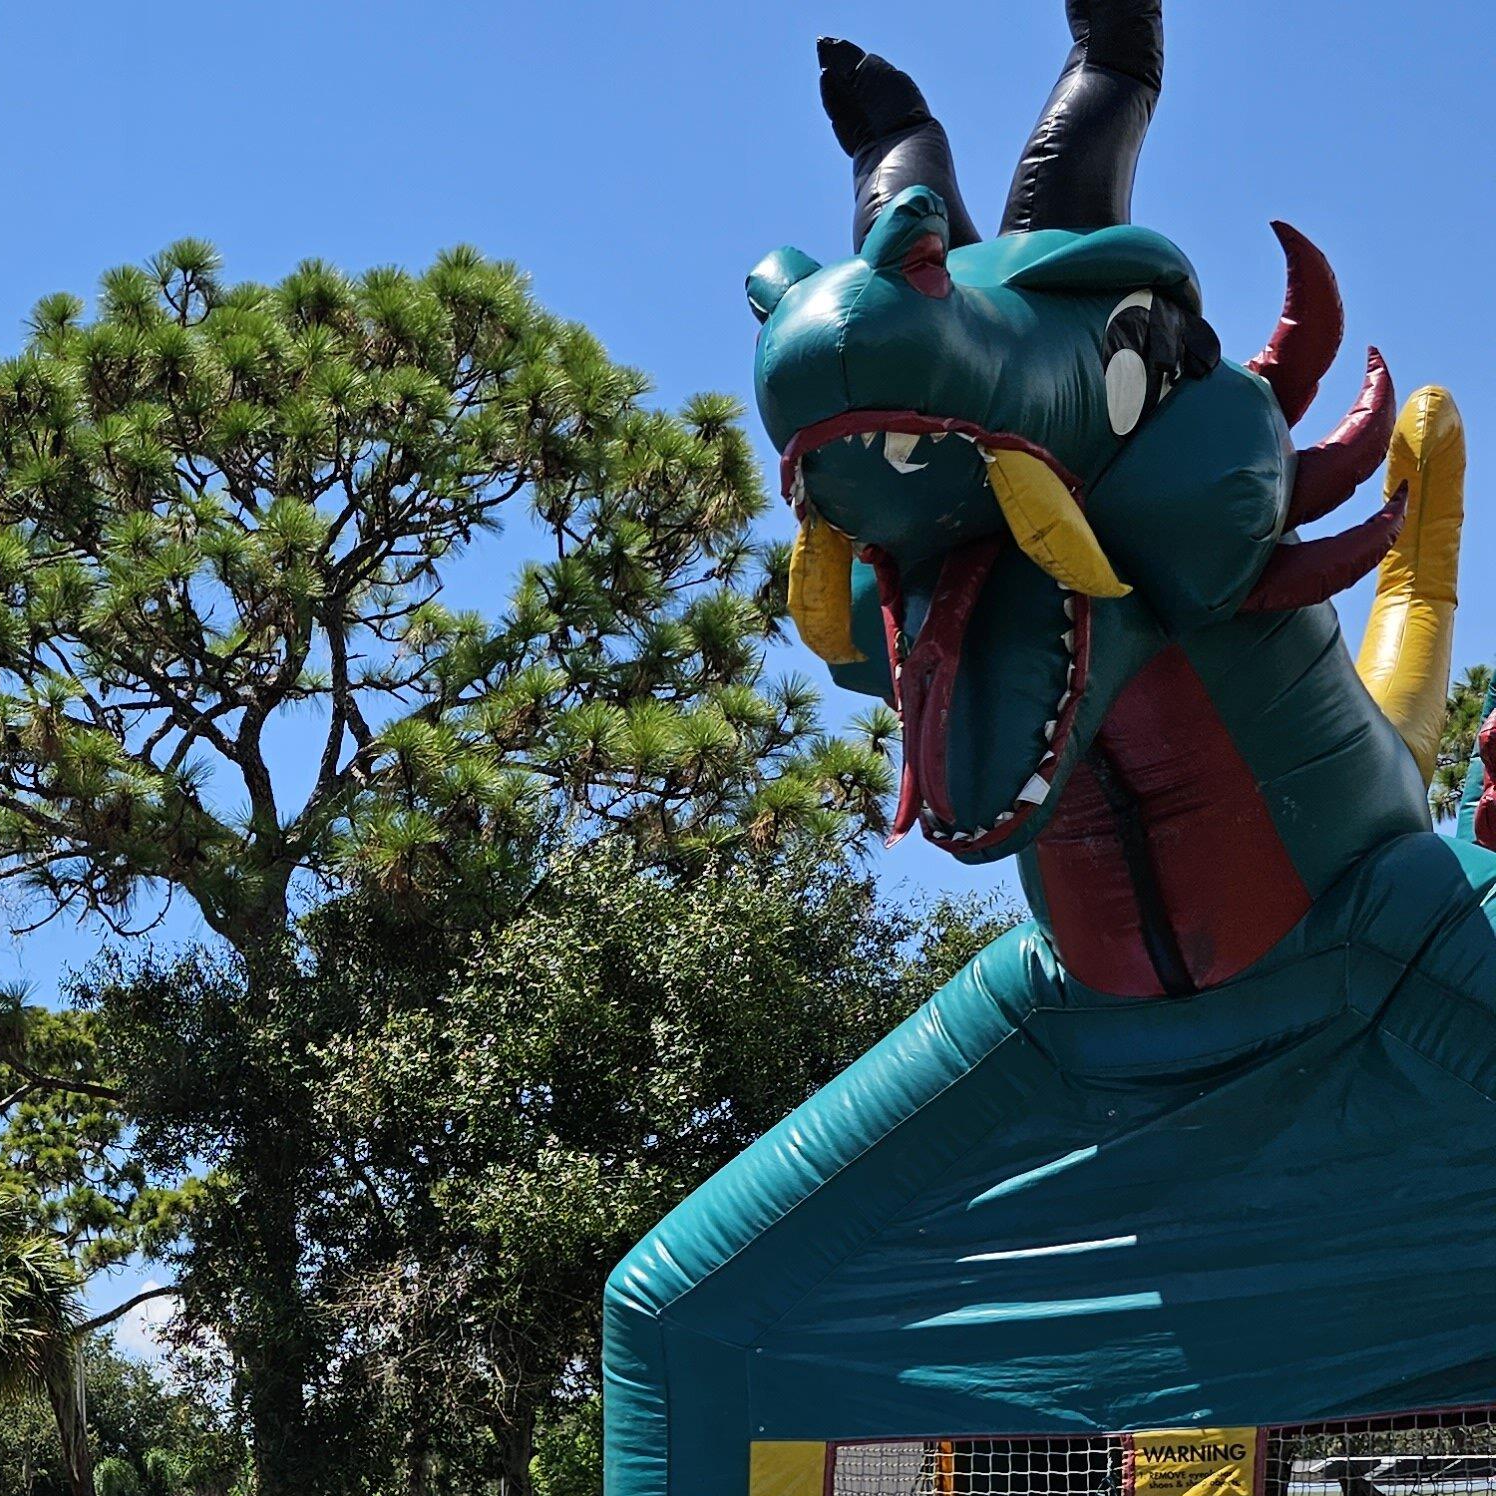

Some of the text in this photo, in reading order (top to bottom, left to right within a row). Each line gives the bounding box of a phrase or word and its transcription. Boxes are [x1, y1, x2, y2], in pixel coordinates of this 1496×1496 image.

[1143, 1444, 1246, 1462] WARNING
[1149, 1471, 1186, 1480] REMOVE
[1149, 1481, 1173, 1489] shoes
